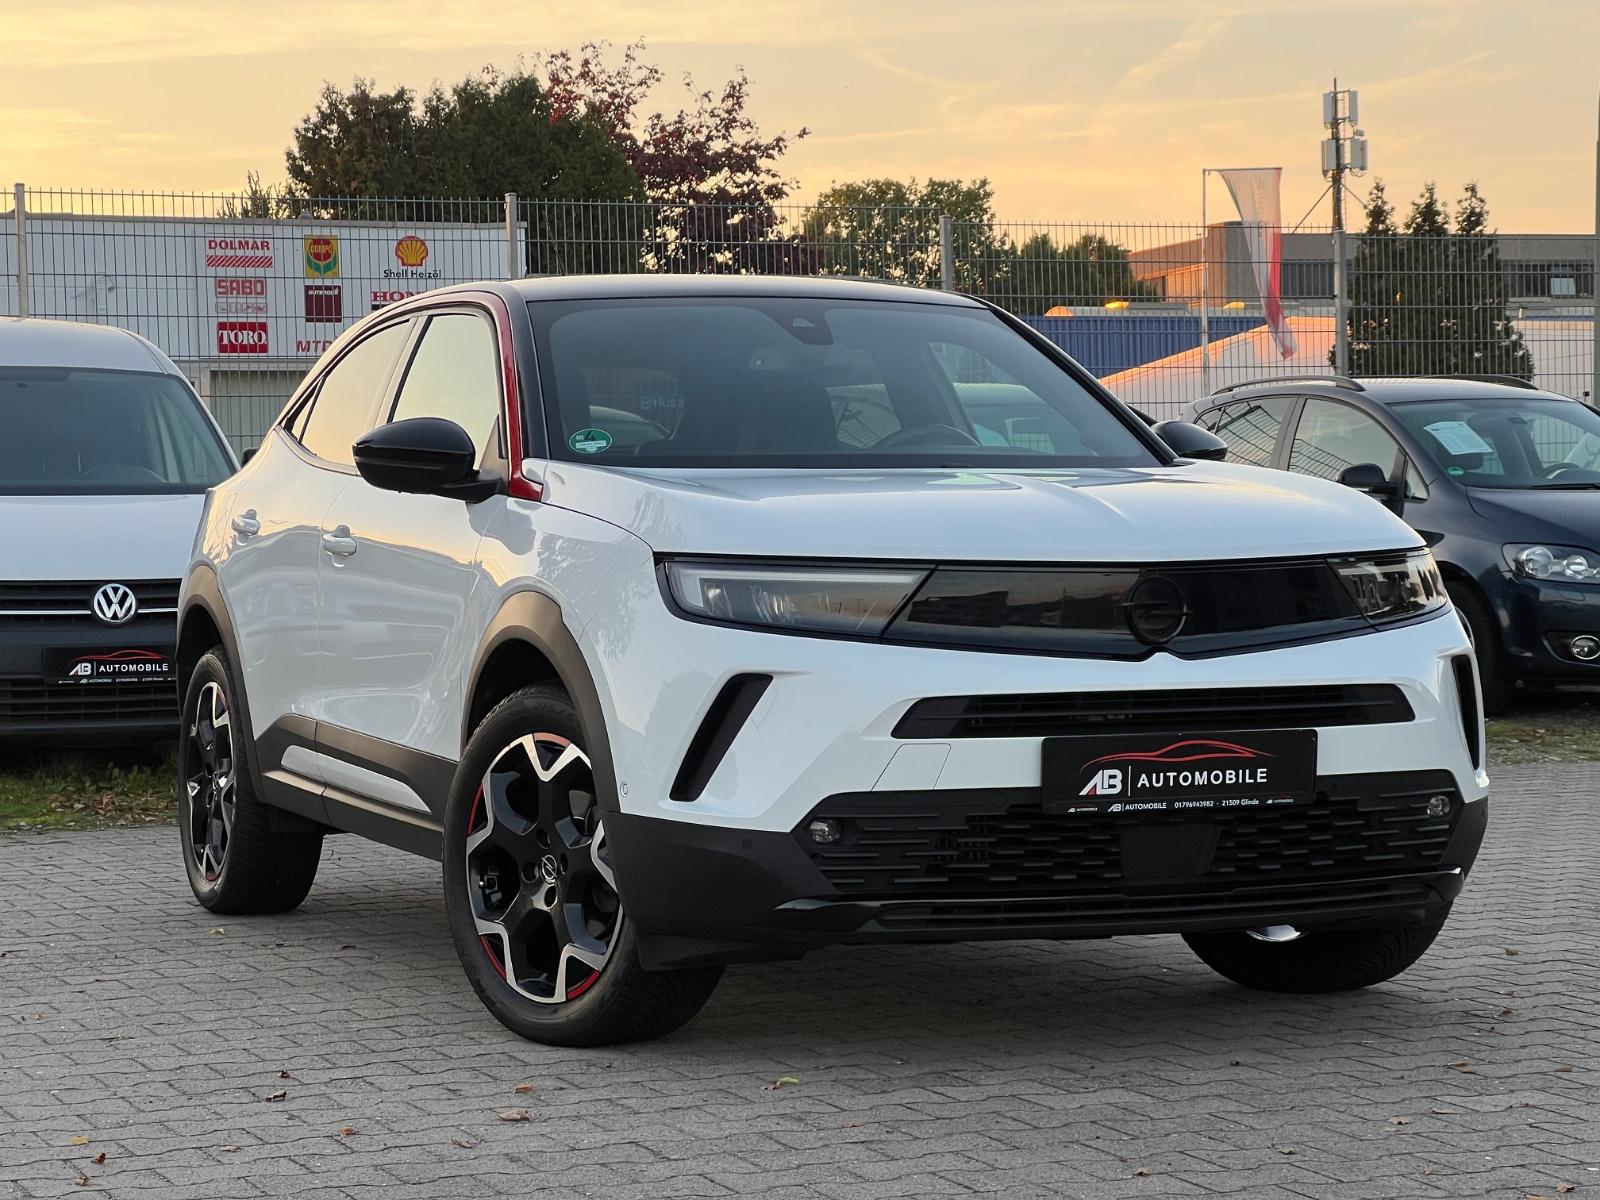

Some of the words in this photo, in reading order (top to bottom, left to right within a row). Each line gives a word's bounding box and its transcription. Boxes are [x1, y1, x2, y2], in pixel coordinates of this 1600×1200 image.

[208, 239, 270, 251] DOLMAR
[310, 244, 333, 254] COMPO
[383, 269, 408, 278] Shell
[410, 269, 442, 278] Heizöl
[217, 279, 265, 296] SABO
[219, 330, 266, 344] TORO
[69, 662, 92, 675] AB
[99, 663, 169, 673] AUTOMOBILE
[1079, 769, 1123, 795] AB
[1137, 768, 1268, 788] AUTOMOBILE
[1125, 802, 1167, 811] AUTOMOBILE
[1222, 799, 1240, 807] 21509
[1240, 798, 1260, 806] Glinde
